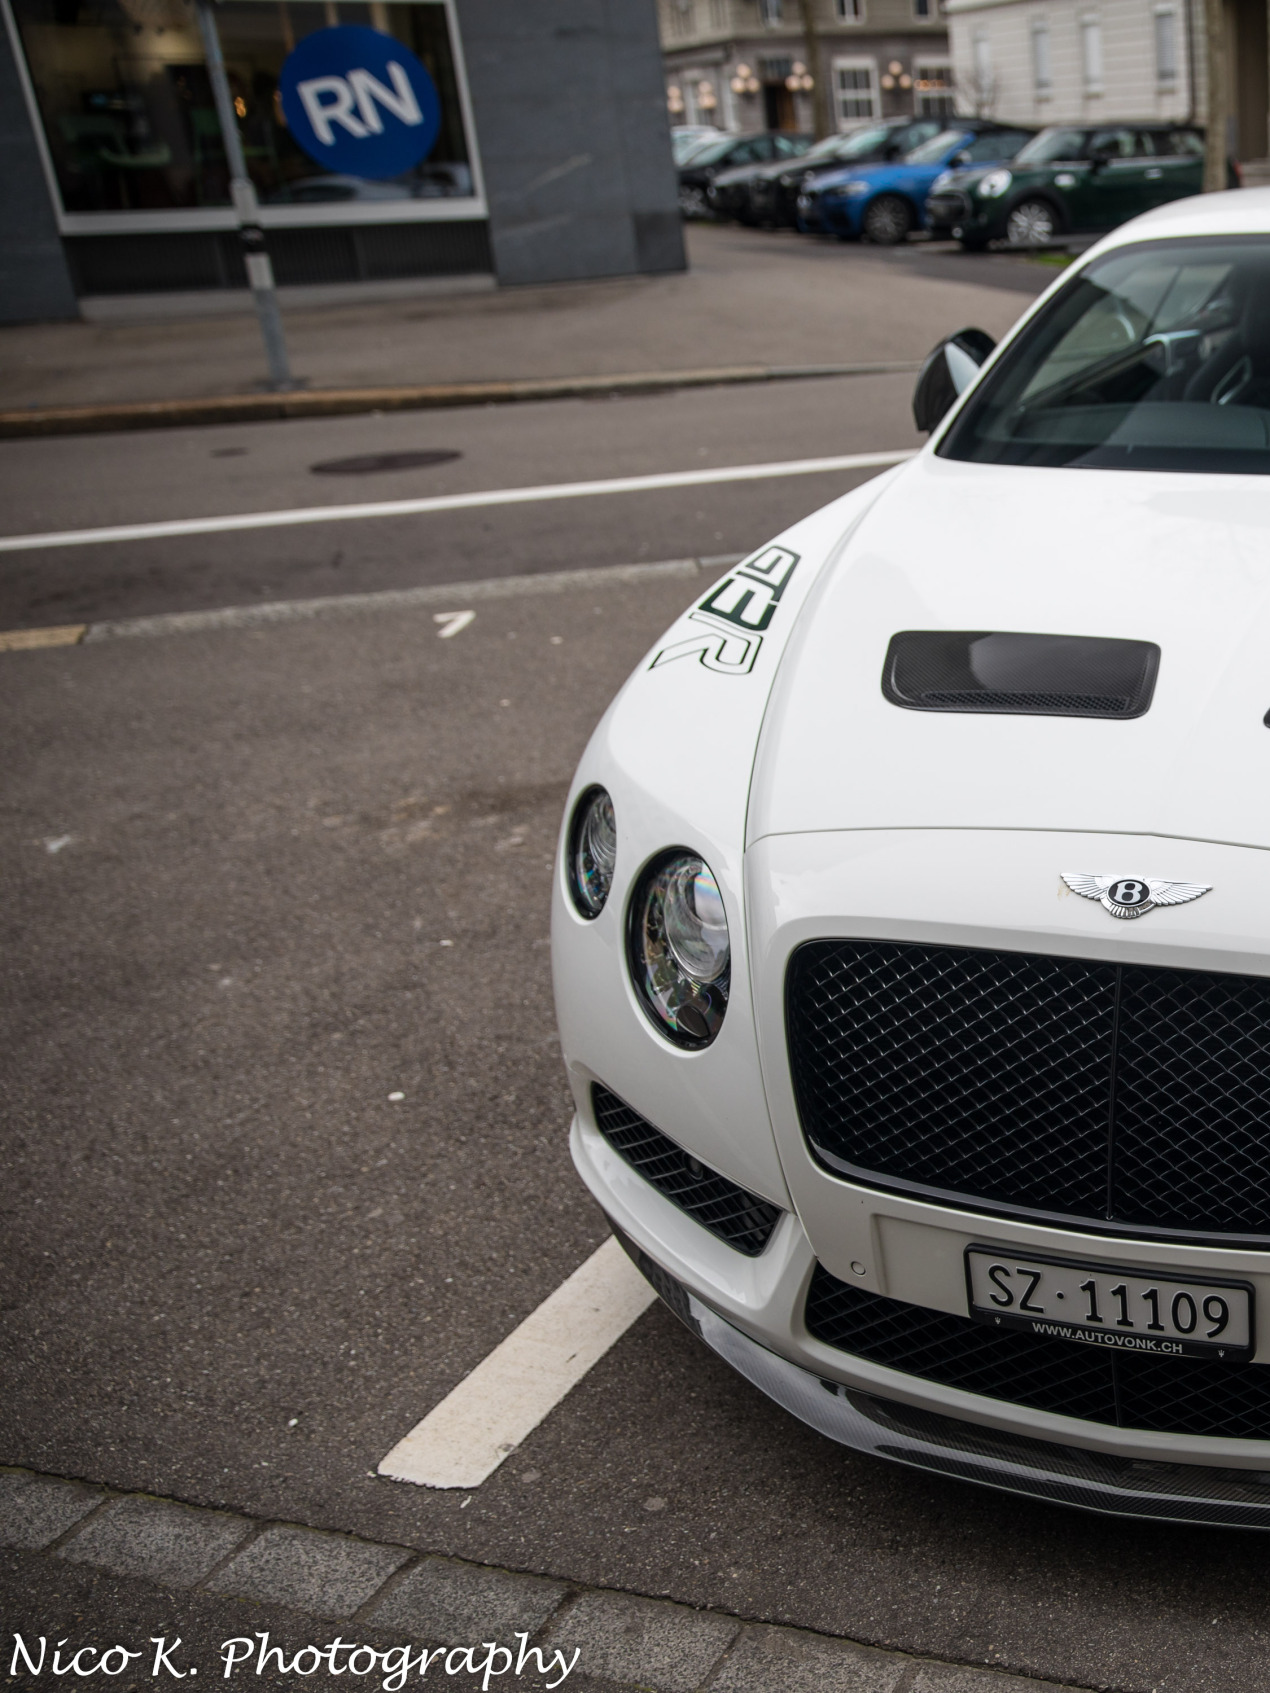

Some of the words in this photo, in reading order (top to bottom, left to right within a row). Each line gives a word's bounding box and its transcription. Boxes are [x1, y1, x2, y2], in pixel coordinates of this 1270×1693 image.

[297, 61, 424, 146] RN
[1115, 881, 1142, 903] B
[1032, 1322, 1183, 1354] WWW.AUTOVONK.CH
